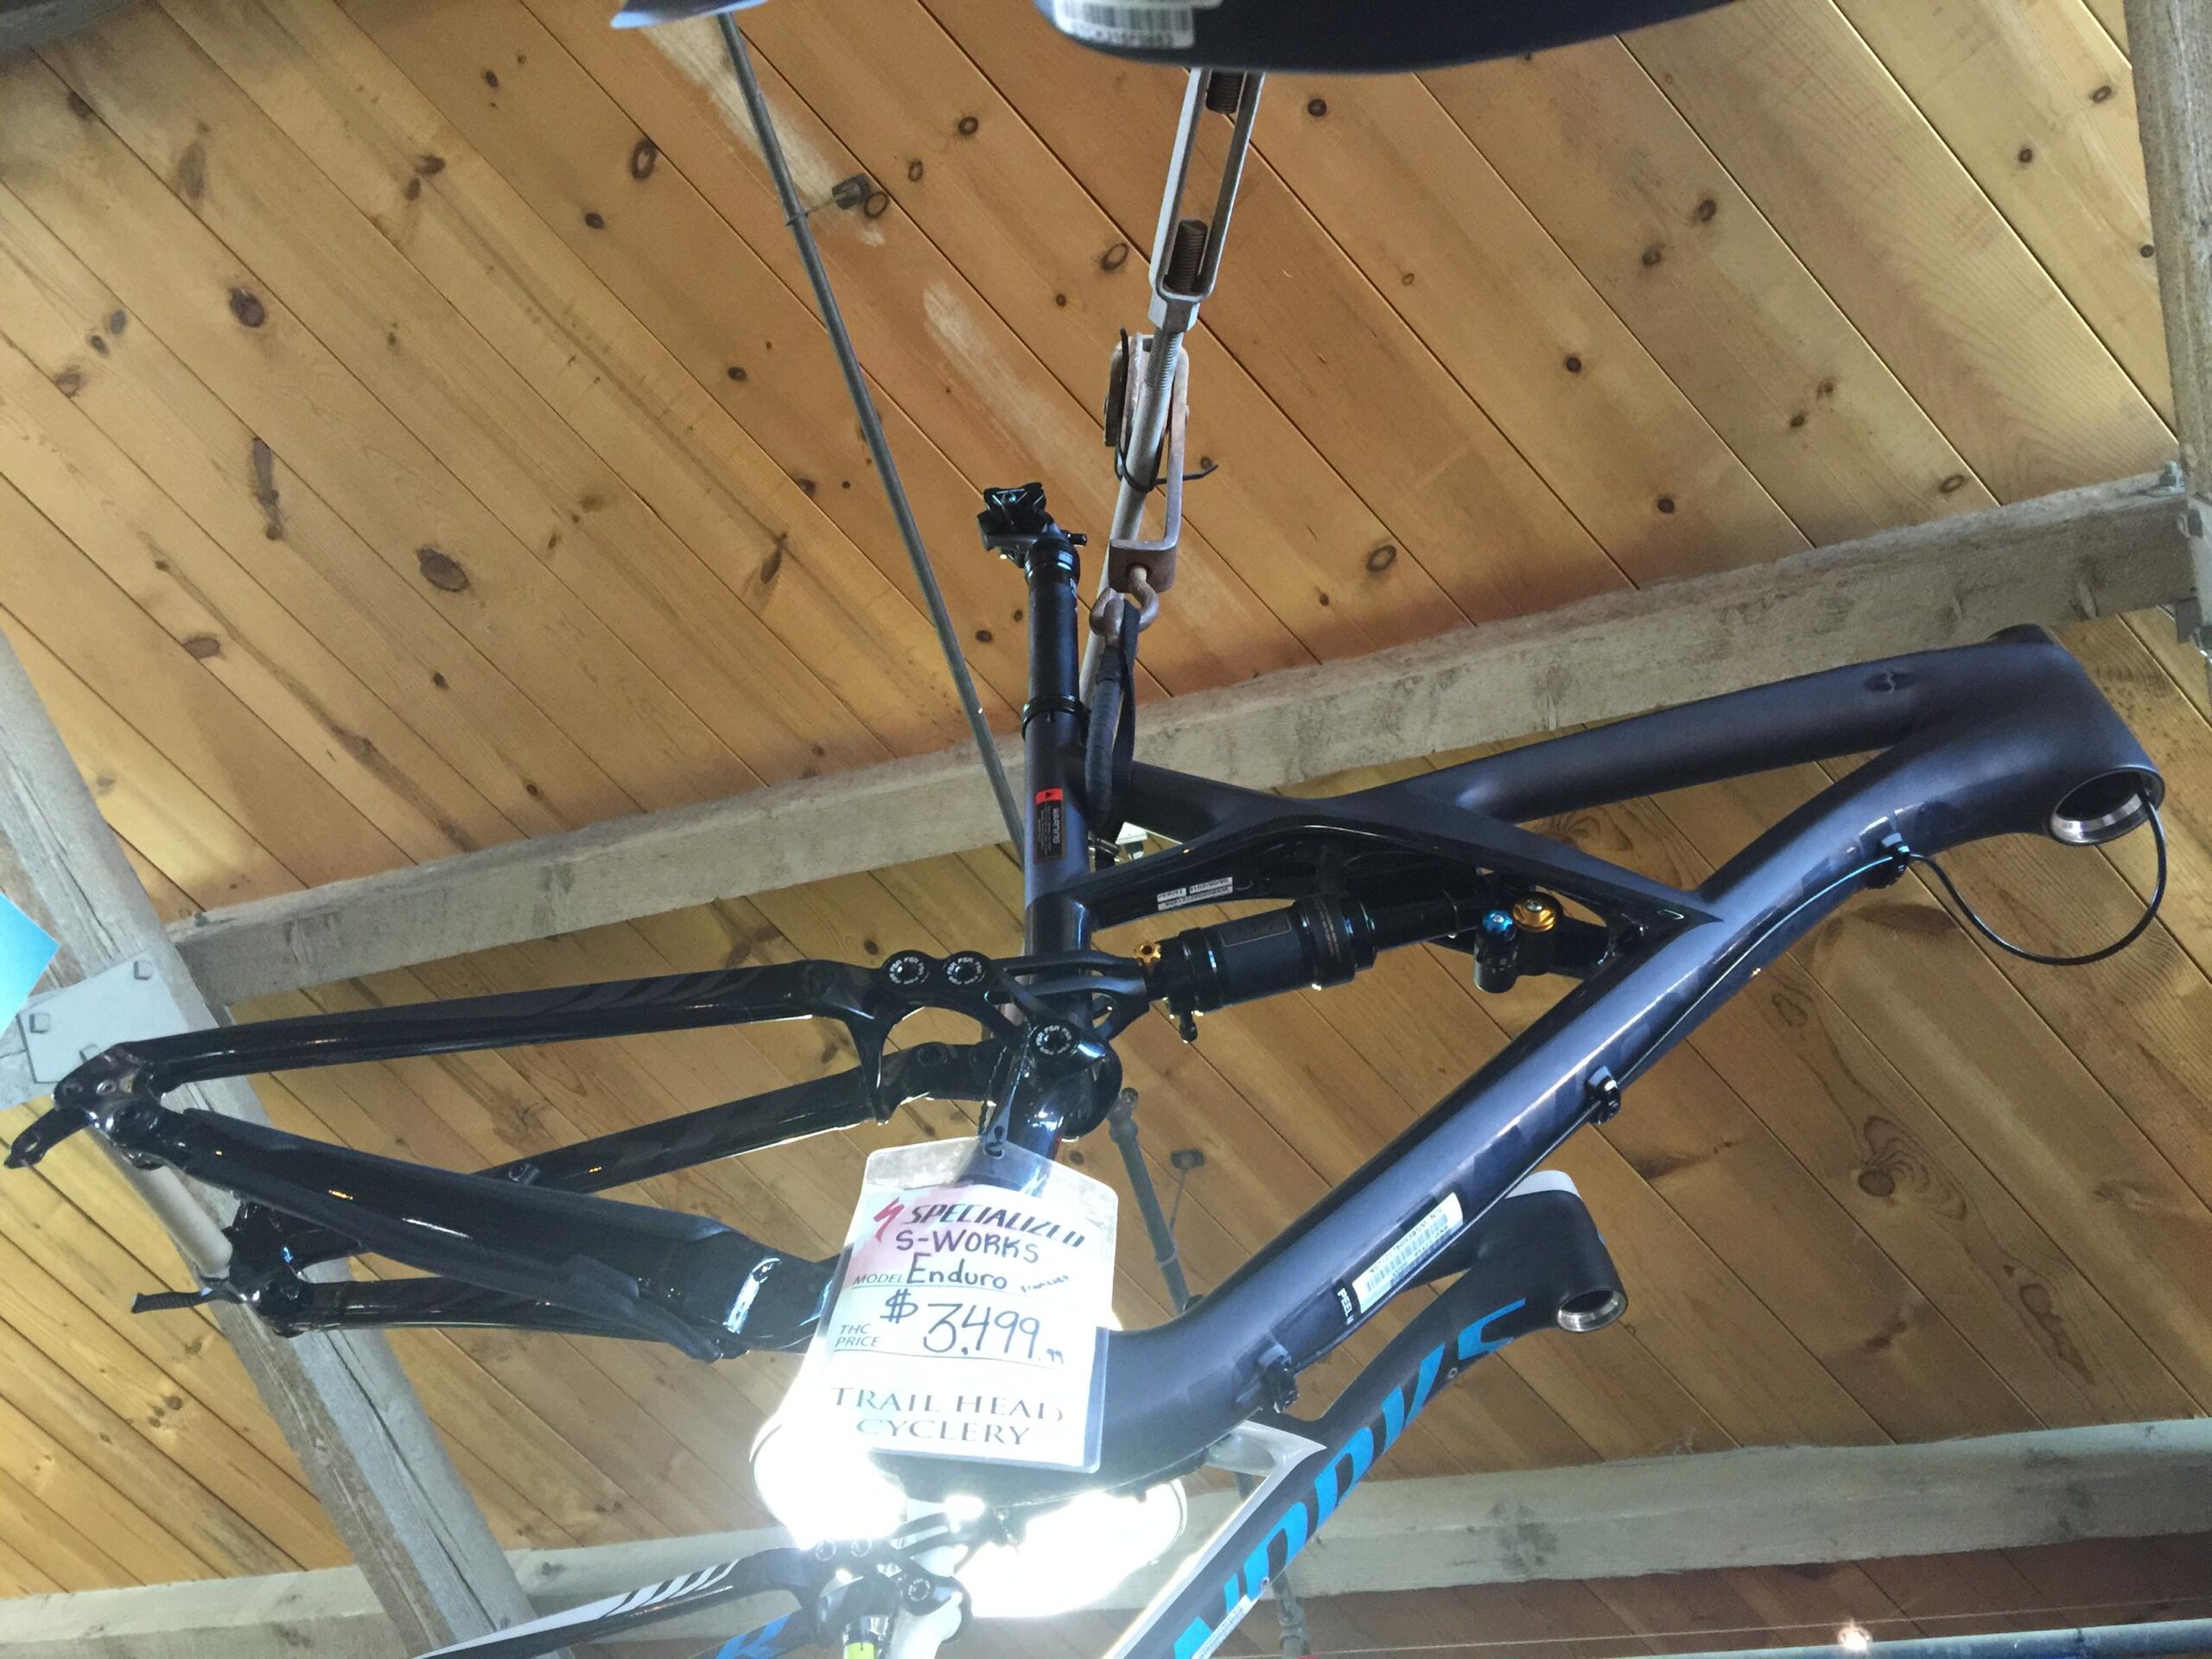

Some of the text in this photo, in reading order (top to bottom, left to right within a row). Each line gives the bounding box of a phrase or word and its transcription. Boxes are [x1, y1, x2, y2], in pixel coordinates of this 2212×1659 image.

[896, 1229, 1039, 1264] S-WORKS
[853, 1274, 904, 1286] MODEL
[906, 1252, 1007, 1290] Enduro
[836, 1336, 881, 1347] PRICE
[841, 1324, 872, 1335] THC
[831, 1387, 1064, 1422] TRAIL HEAD
[856, 1419, 1030, 1446] CYCLERY
